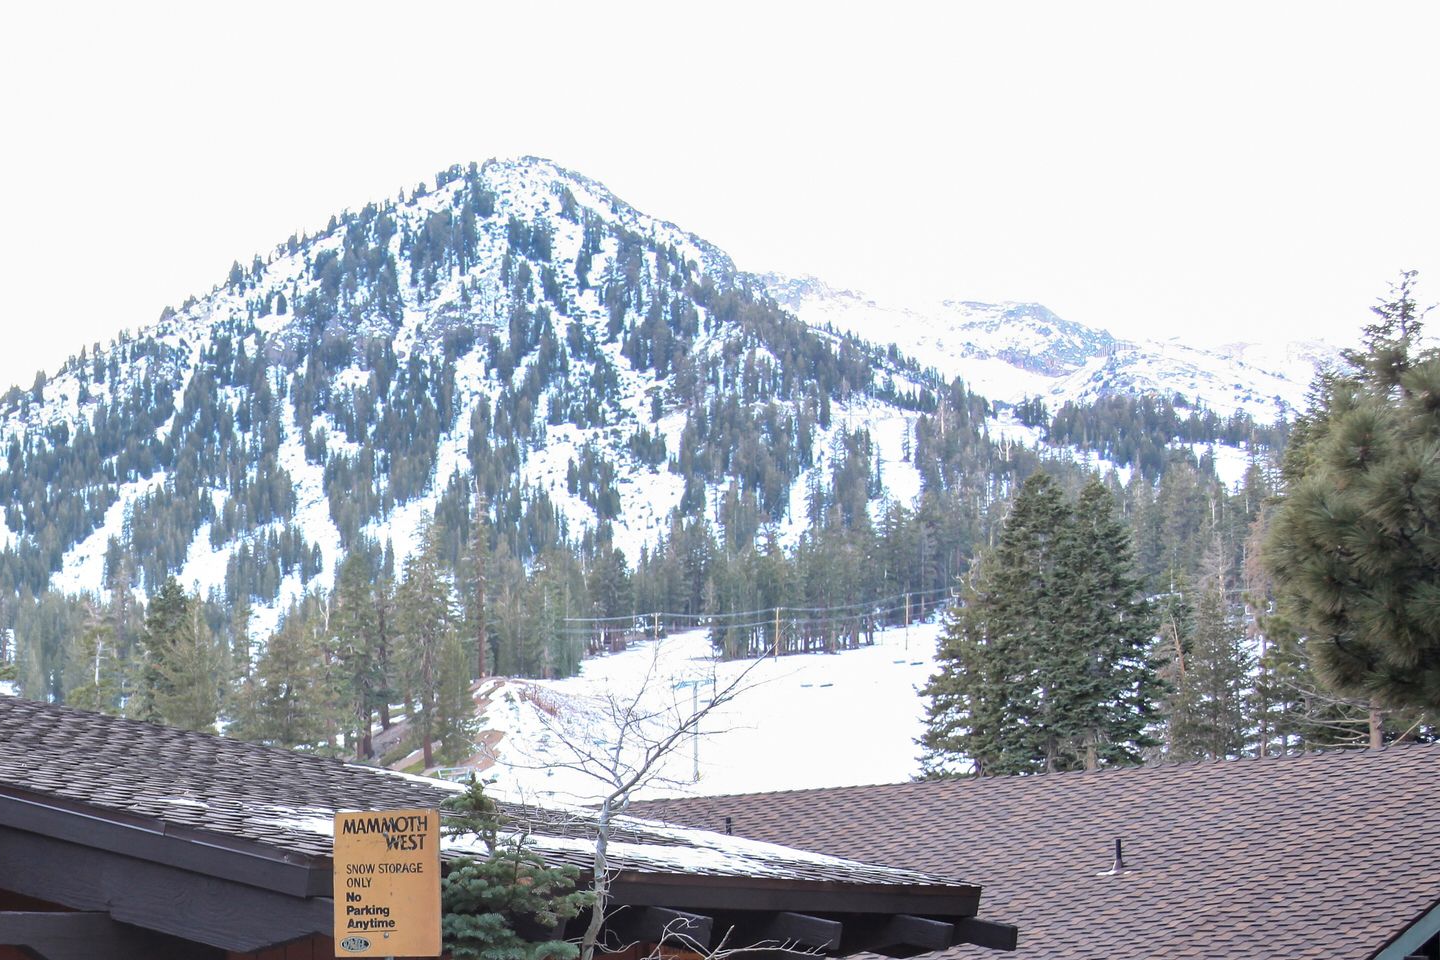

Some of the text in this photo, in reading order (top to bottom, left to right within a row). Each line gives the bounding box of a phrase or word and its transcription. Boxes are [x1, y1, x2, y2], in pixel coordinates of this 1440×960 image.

[343, 816, 427, 834] MAMMOTH
[386, 834, 426, 850] WEST
[346, 863, 423, 874] SNOW STORAGE
[346, 878, 372, 888] ONLY
[346, 892, 362, 902] No
[346, 905, 390, 917] Parking
[347, 918, 396, 930] Anytime
